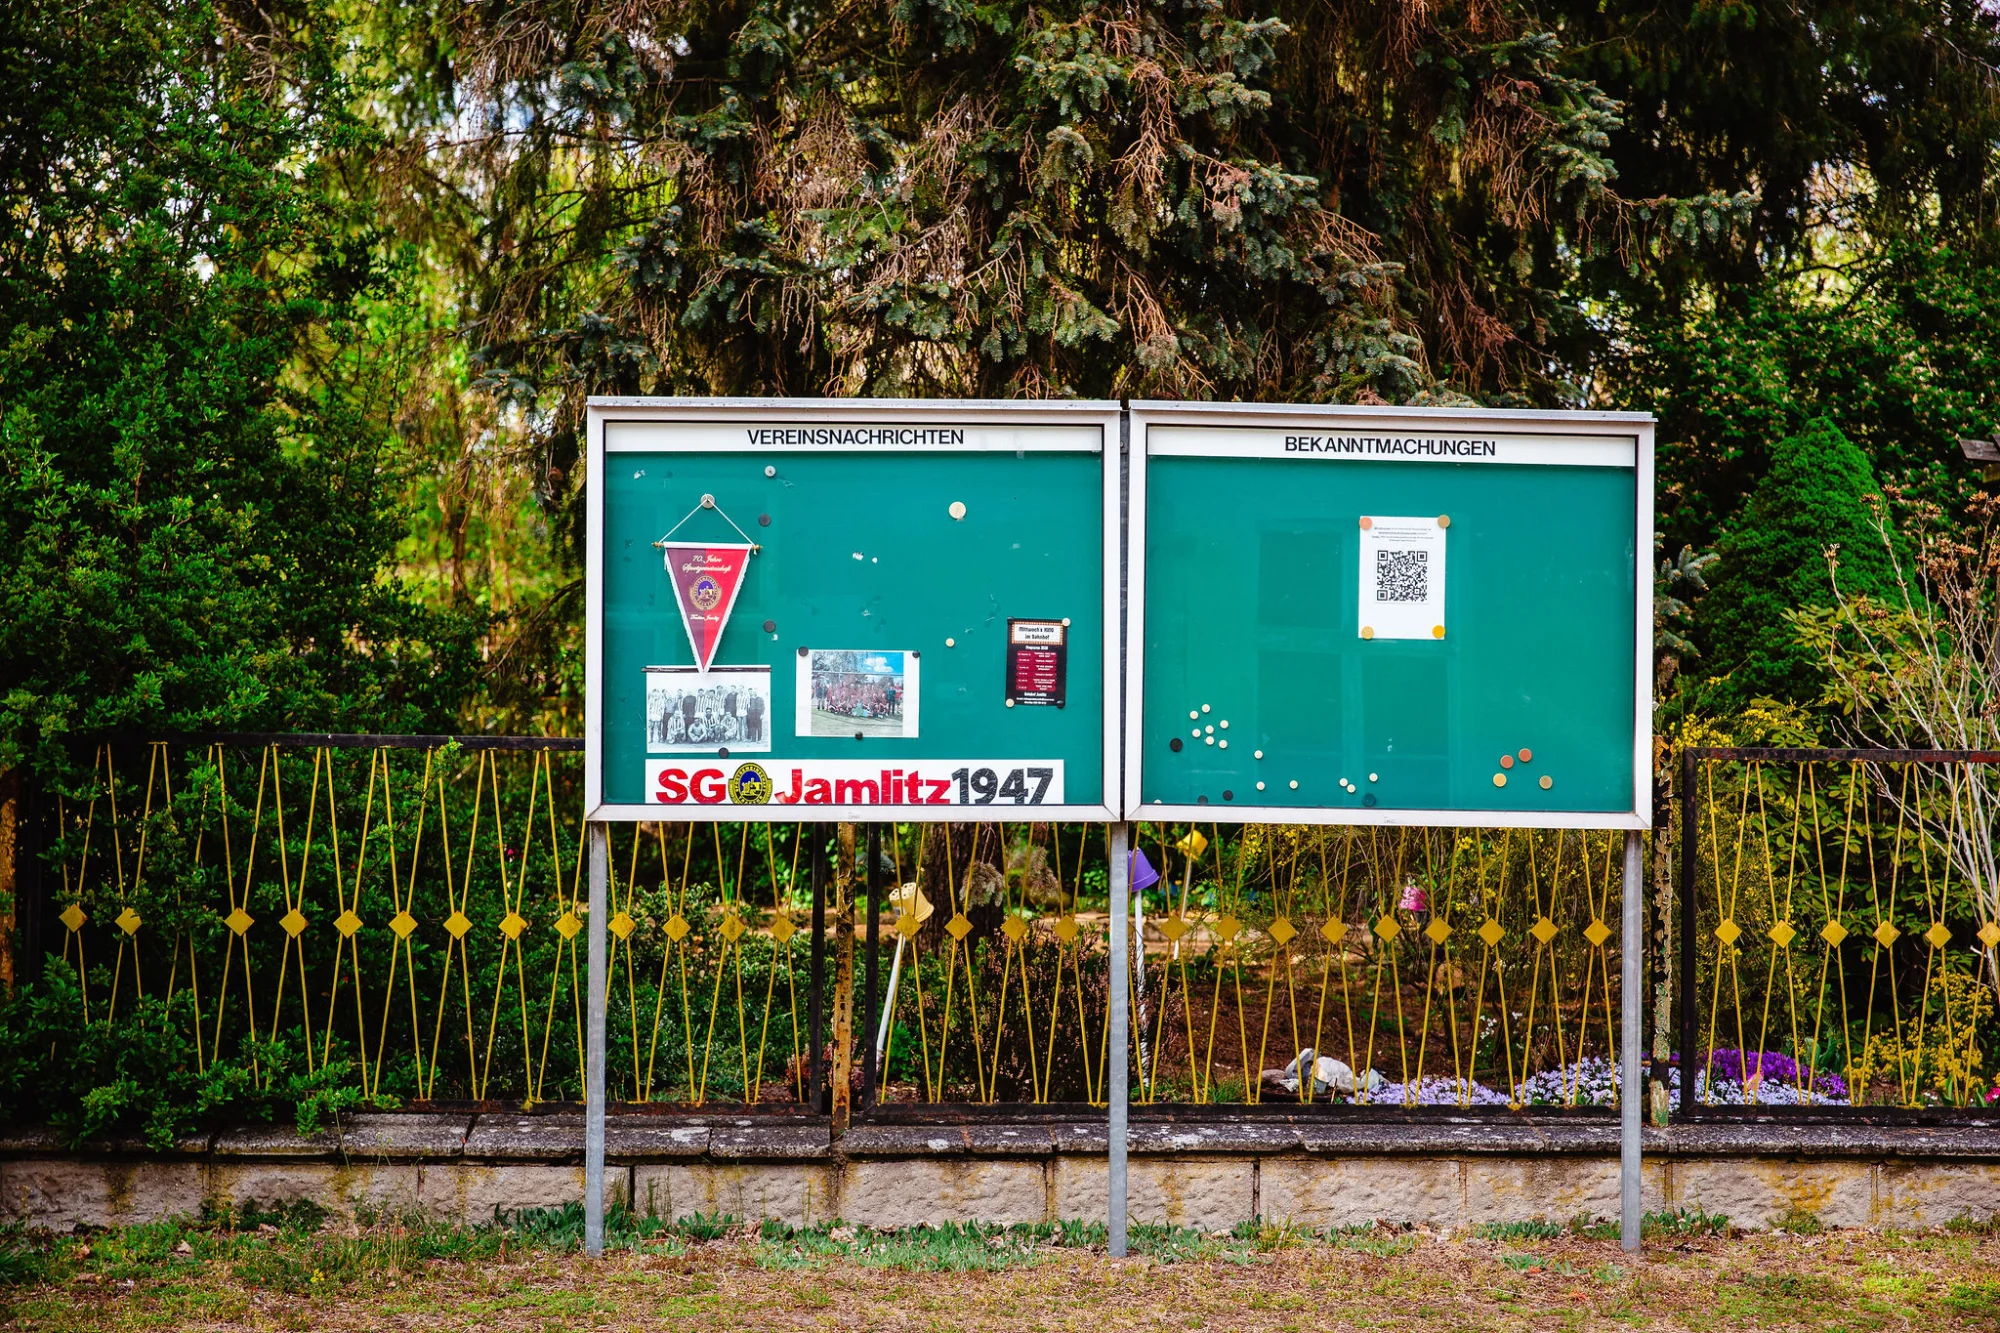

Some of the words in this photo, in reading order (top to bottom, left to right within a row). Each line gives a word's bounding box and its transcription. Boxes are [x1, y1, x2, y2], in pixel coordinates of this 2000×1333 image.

[747, 429, 964, 445] VEREINSNACHRICHTEN
[1285, 436, 1496, 456] BEKANNTMACHUNGEN
[655, 768, 726, 804] SG
[774, 769, 951, 804] Jamlitz
[951, 767, 1054, 804] 1947
